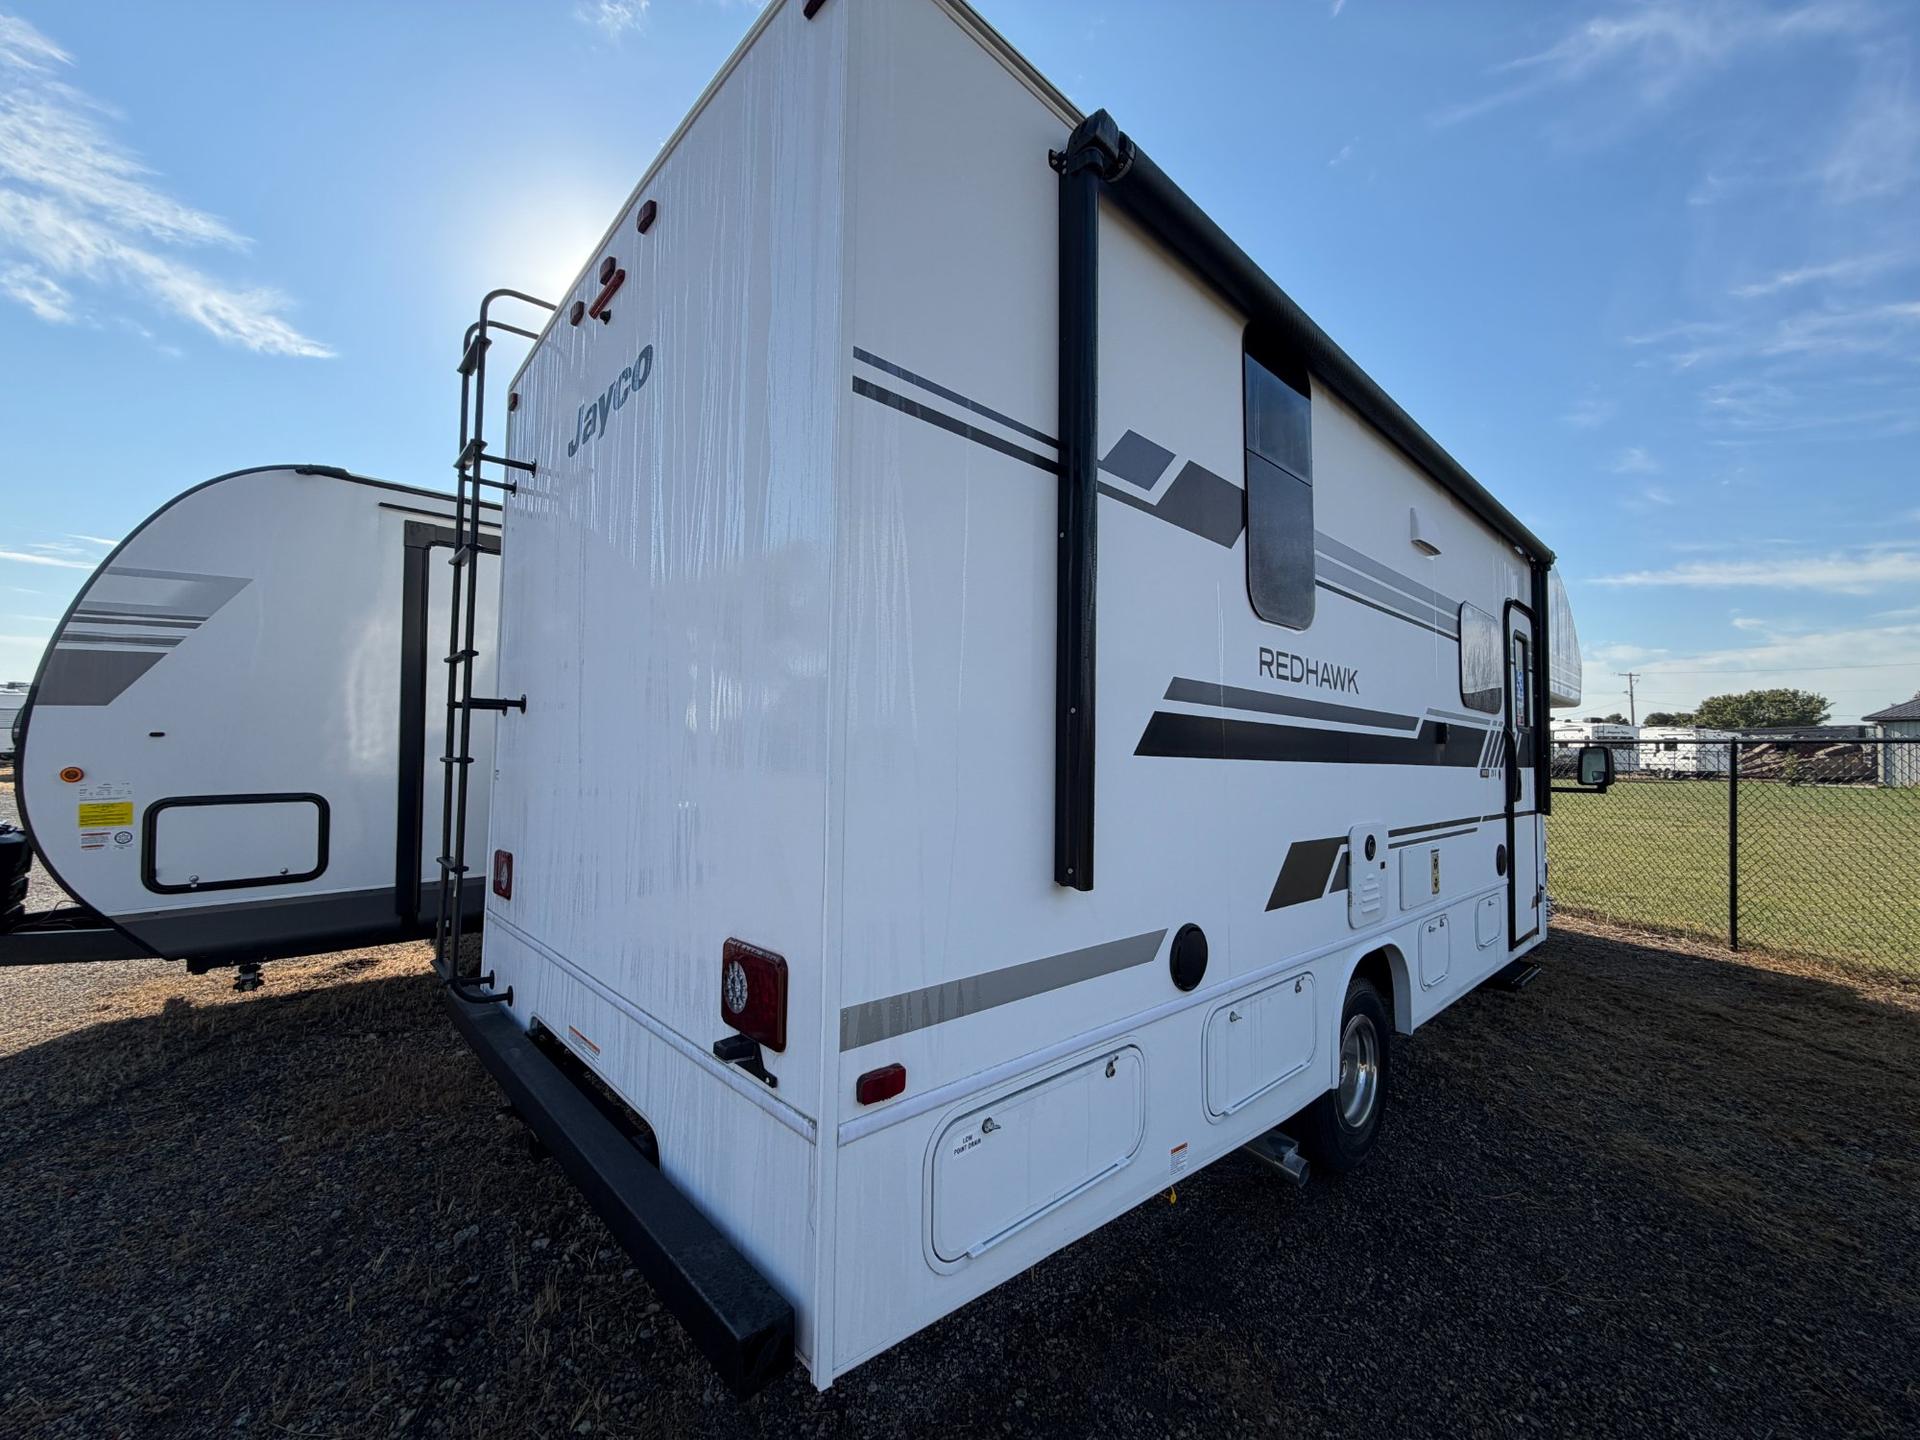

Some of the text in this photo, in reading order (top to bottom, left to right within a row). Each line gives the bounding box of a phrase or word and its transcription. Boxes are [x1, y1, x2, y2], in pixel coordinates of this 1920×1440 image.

[567, 343, 654, 458] Jayco
[1259, 646, 1360, 695] REDHAWK
[953, 1144, 967, 1155] POINT
